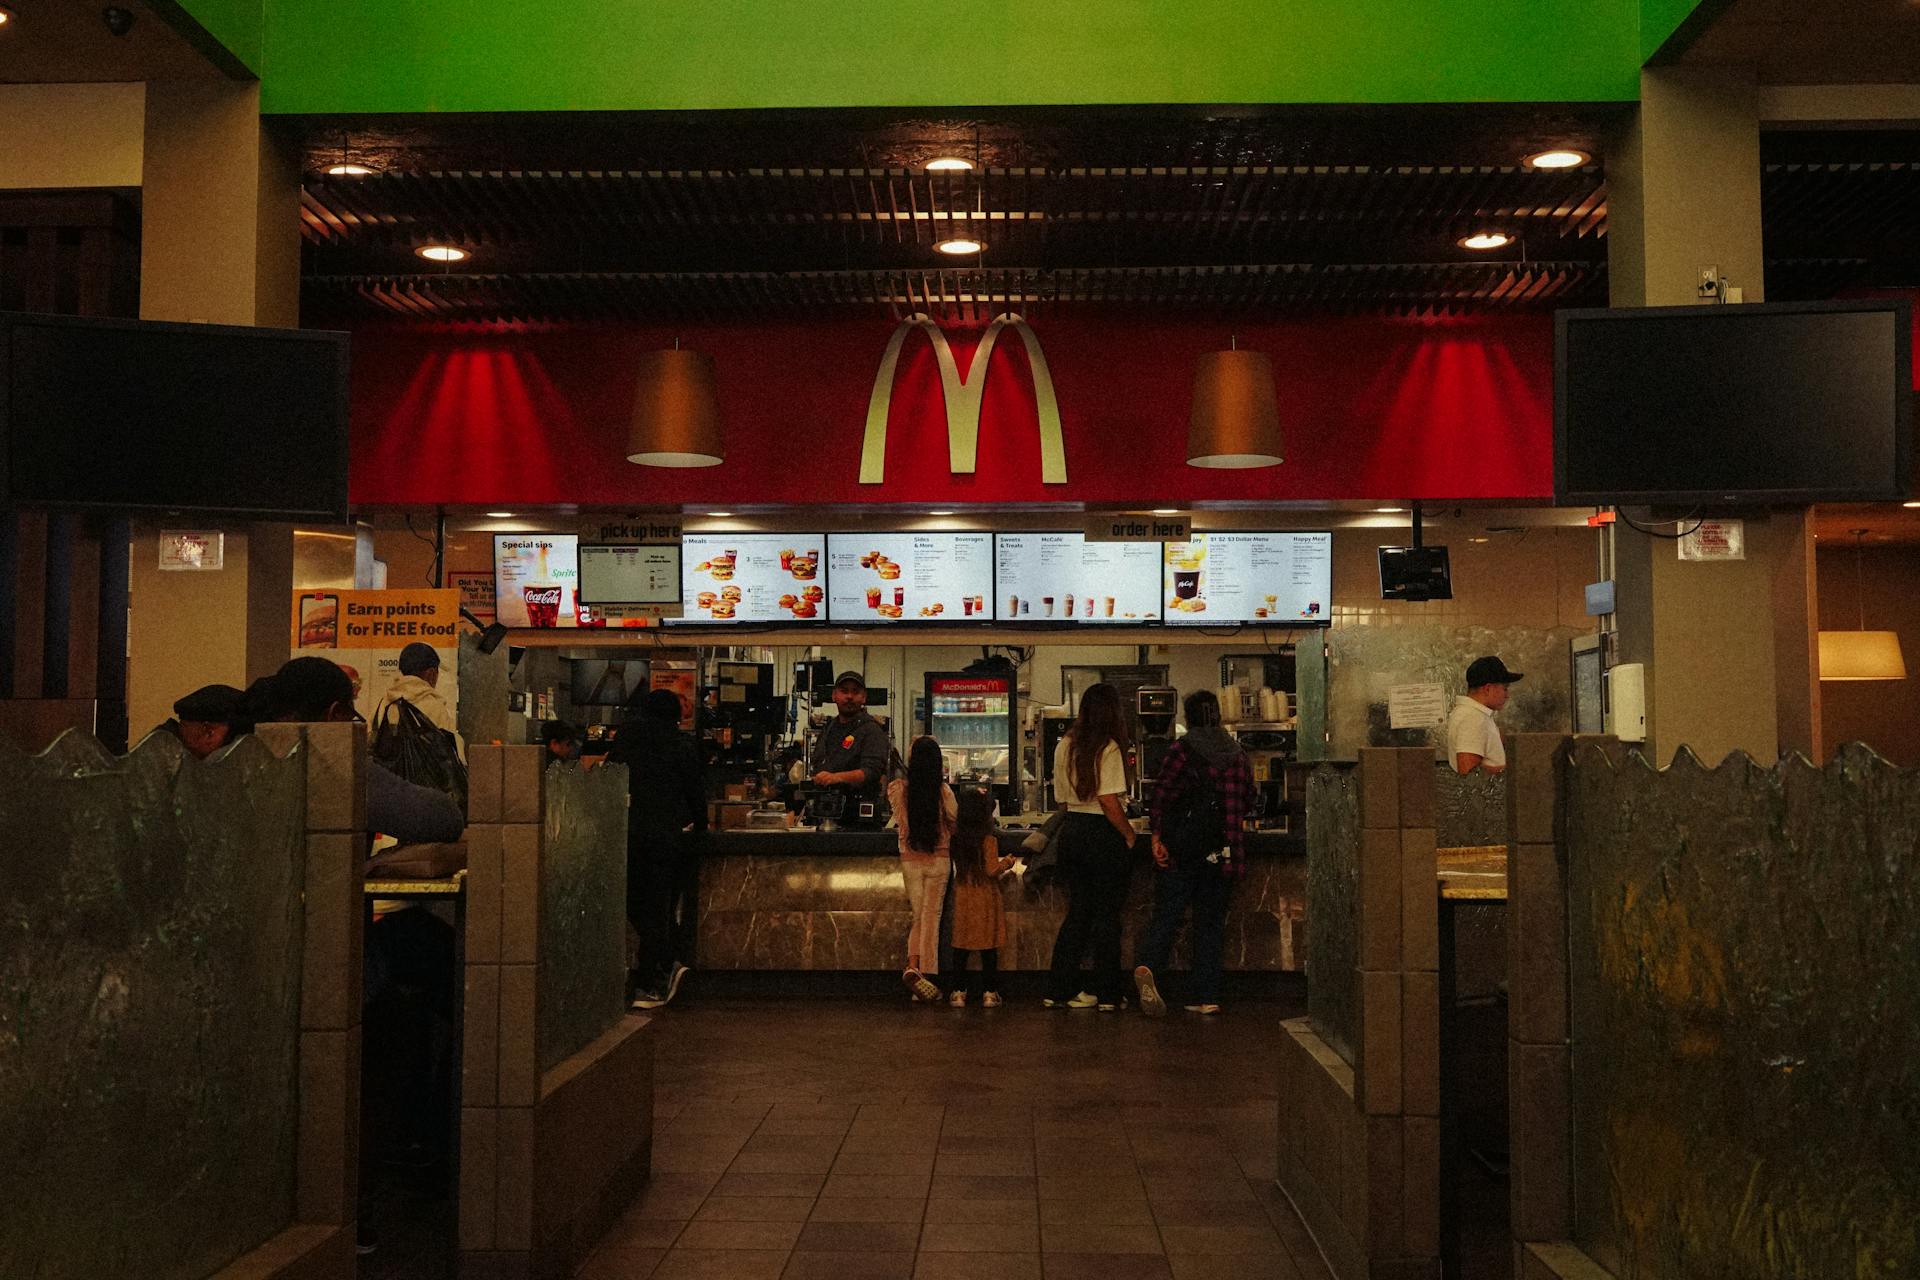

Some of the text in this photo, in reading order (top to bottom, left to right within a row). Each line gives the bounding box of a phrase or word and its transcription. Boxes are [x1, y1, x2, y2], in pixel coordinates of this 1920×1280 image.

[600, 522, 680, 541] pick up here
[1112, 522, 1184, 536] order here
[502, 541, 553, 550] Special sips
[552, 568, 577, 578] Sprite
[347, 602, 436, 619] Earn points
[346, 622, 455, 636] for FREE food
